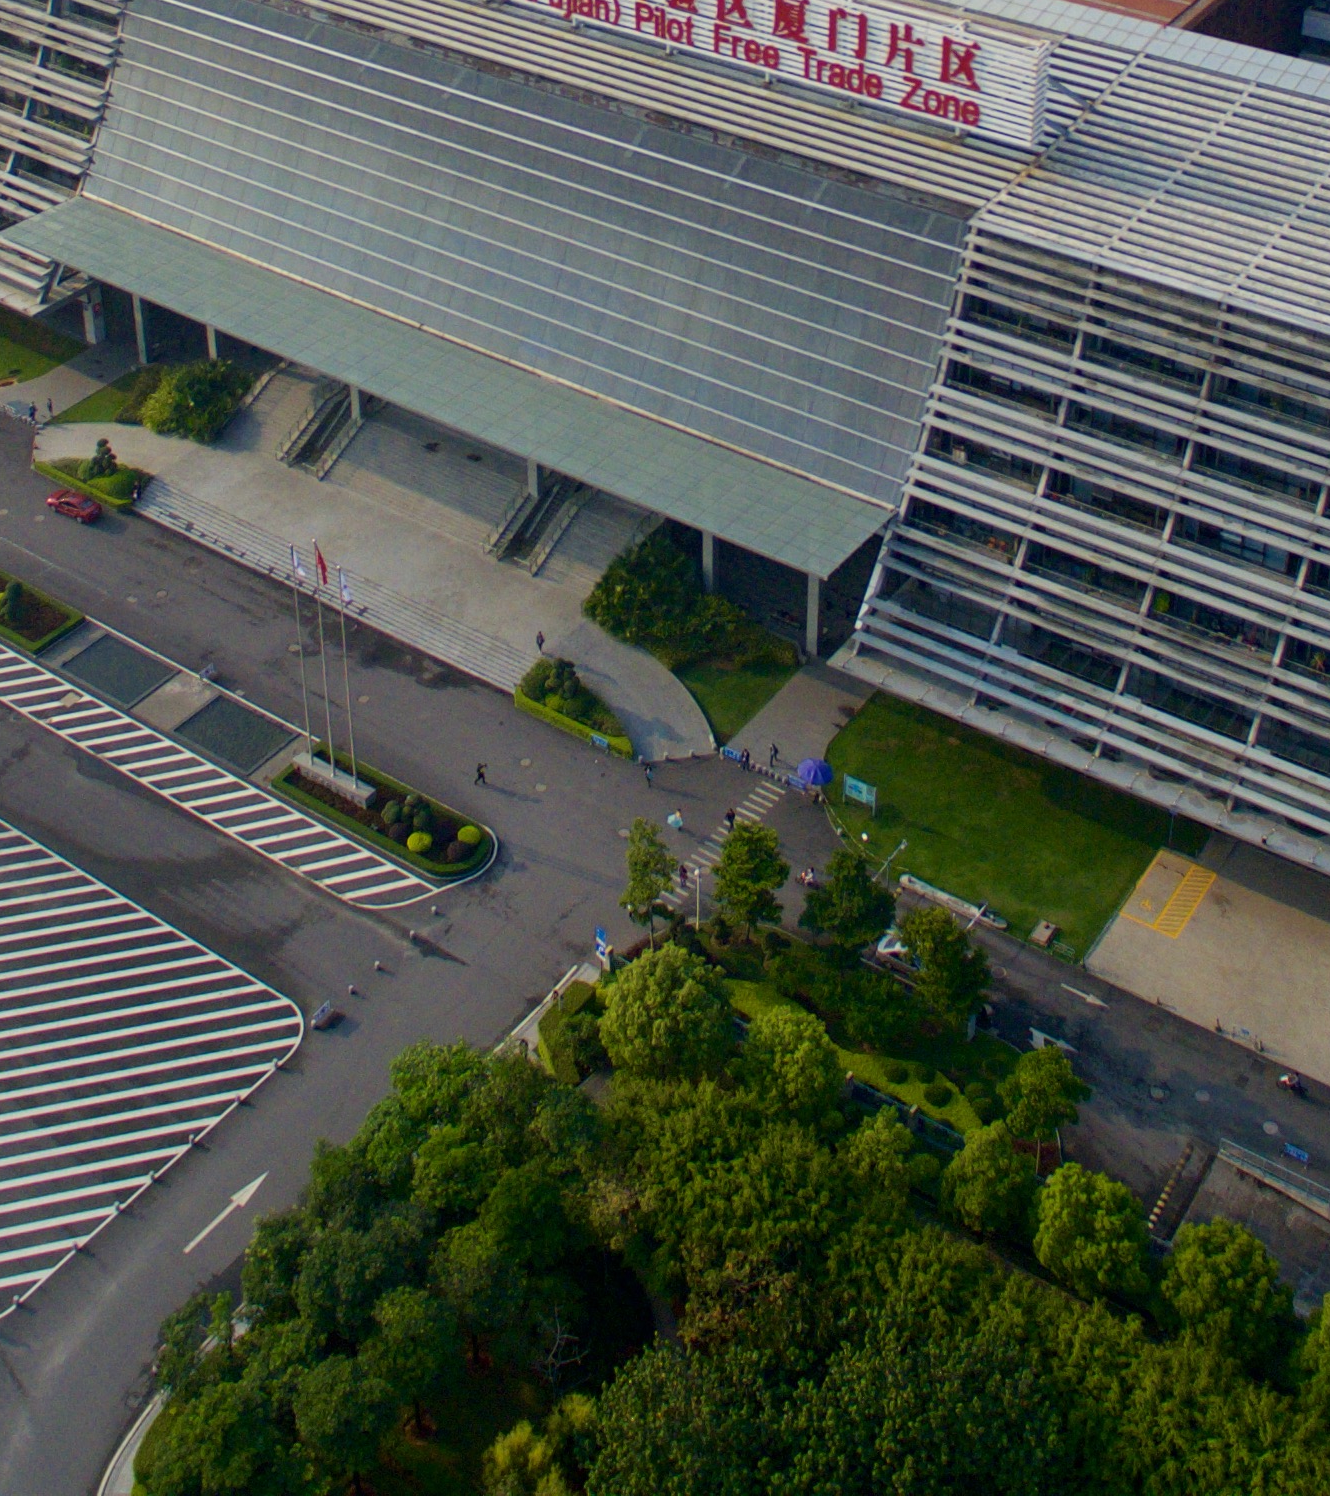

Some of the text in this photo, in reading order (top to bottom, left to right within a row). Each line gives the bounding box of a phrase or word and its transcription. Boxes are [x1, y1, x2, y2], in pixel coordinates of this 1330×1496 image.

[635, 2, 693, 46] Pilot
[713, 22, 780, 70] Free
[798, 45, 883, 99] Trade
[900, 76, 981, 127] Zone
